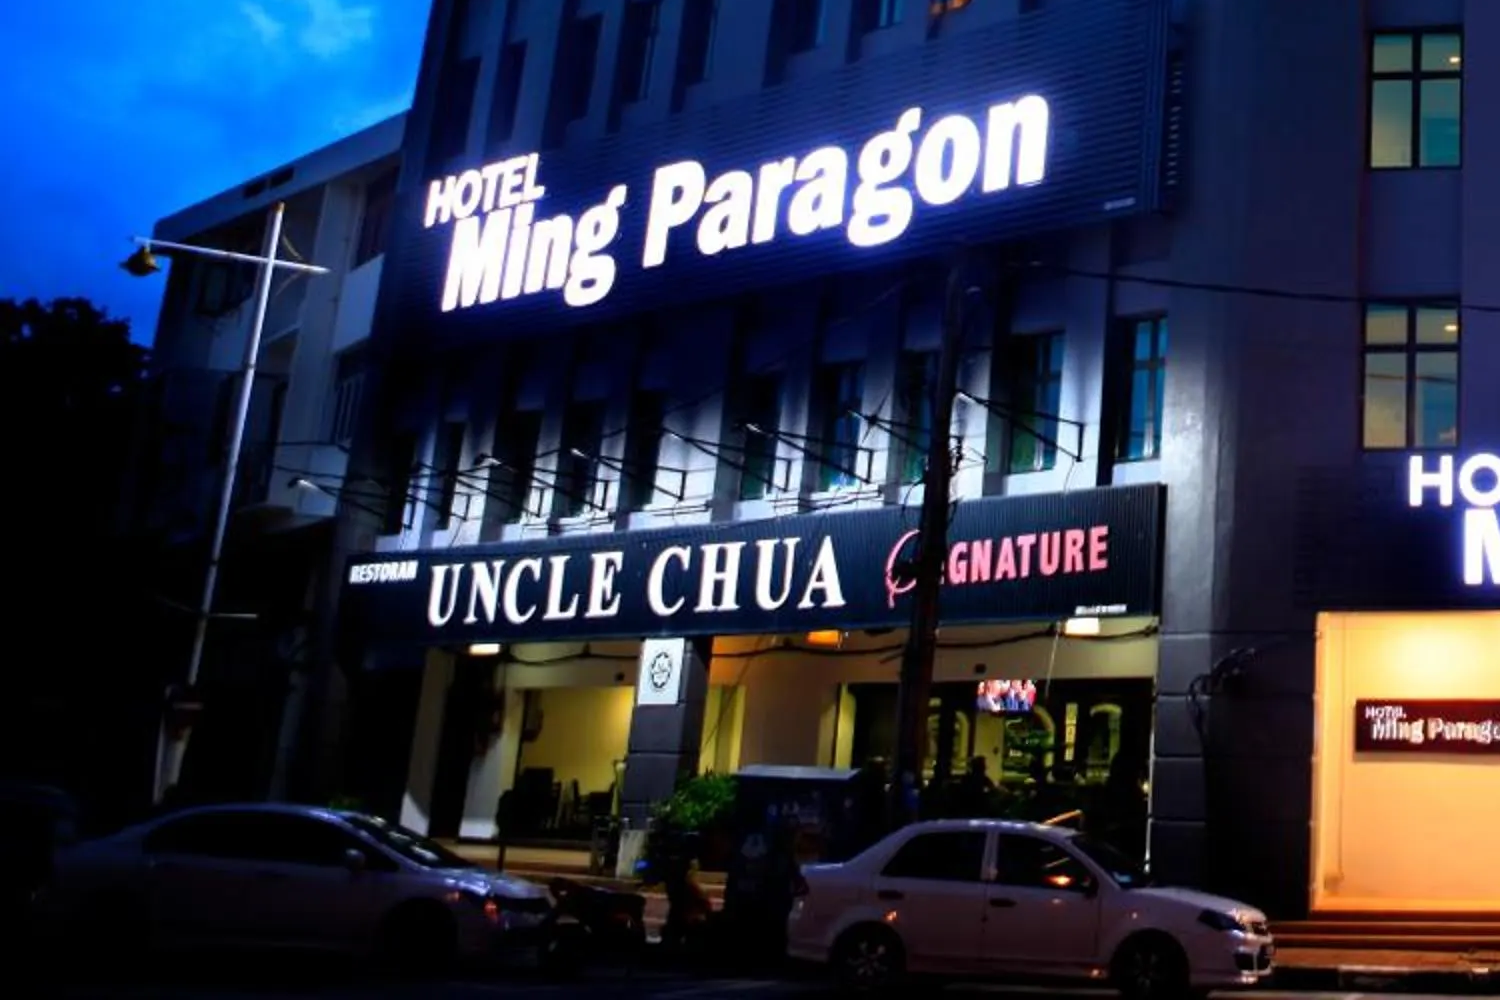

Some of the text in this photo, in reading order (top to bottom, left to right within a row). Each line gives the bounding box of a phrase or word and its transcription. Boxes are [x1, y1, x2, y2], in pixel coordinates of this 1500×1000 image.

[424, 152, 546, 229] HOTEL
[441, 184, 628, 313] Ming
[642, 94, 1049, 268] Paragon
[349, 560, 418, 584] RESTORAN
[427, 536, 846, 627] UNCLE CHUA
[1365, 706, 1407, 719] HOTEL
[1372, 718, 1424, 744] Ming
